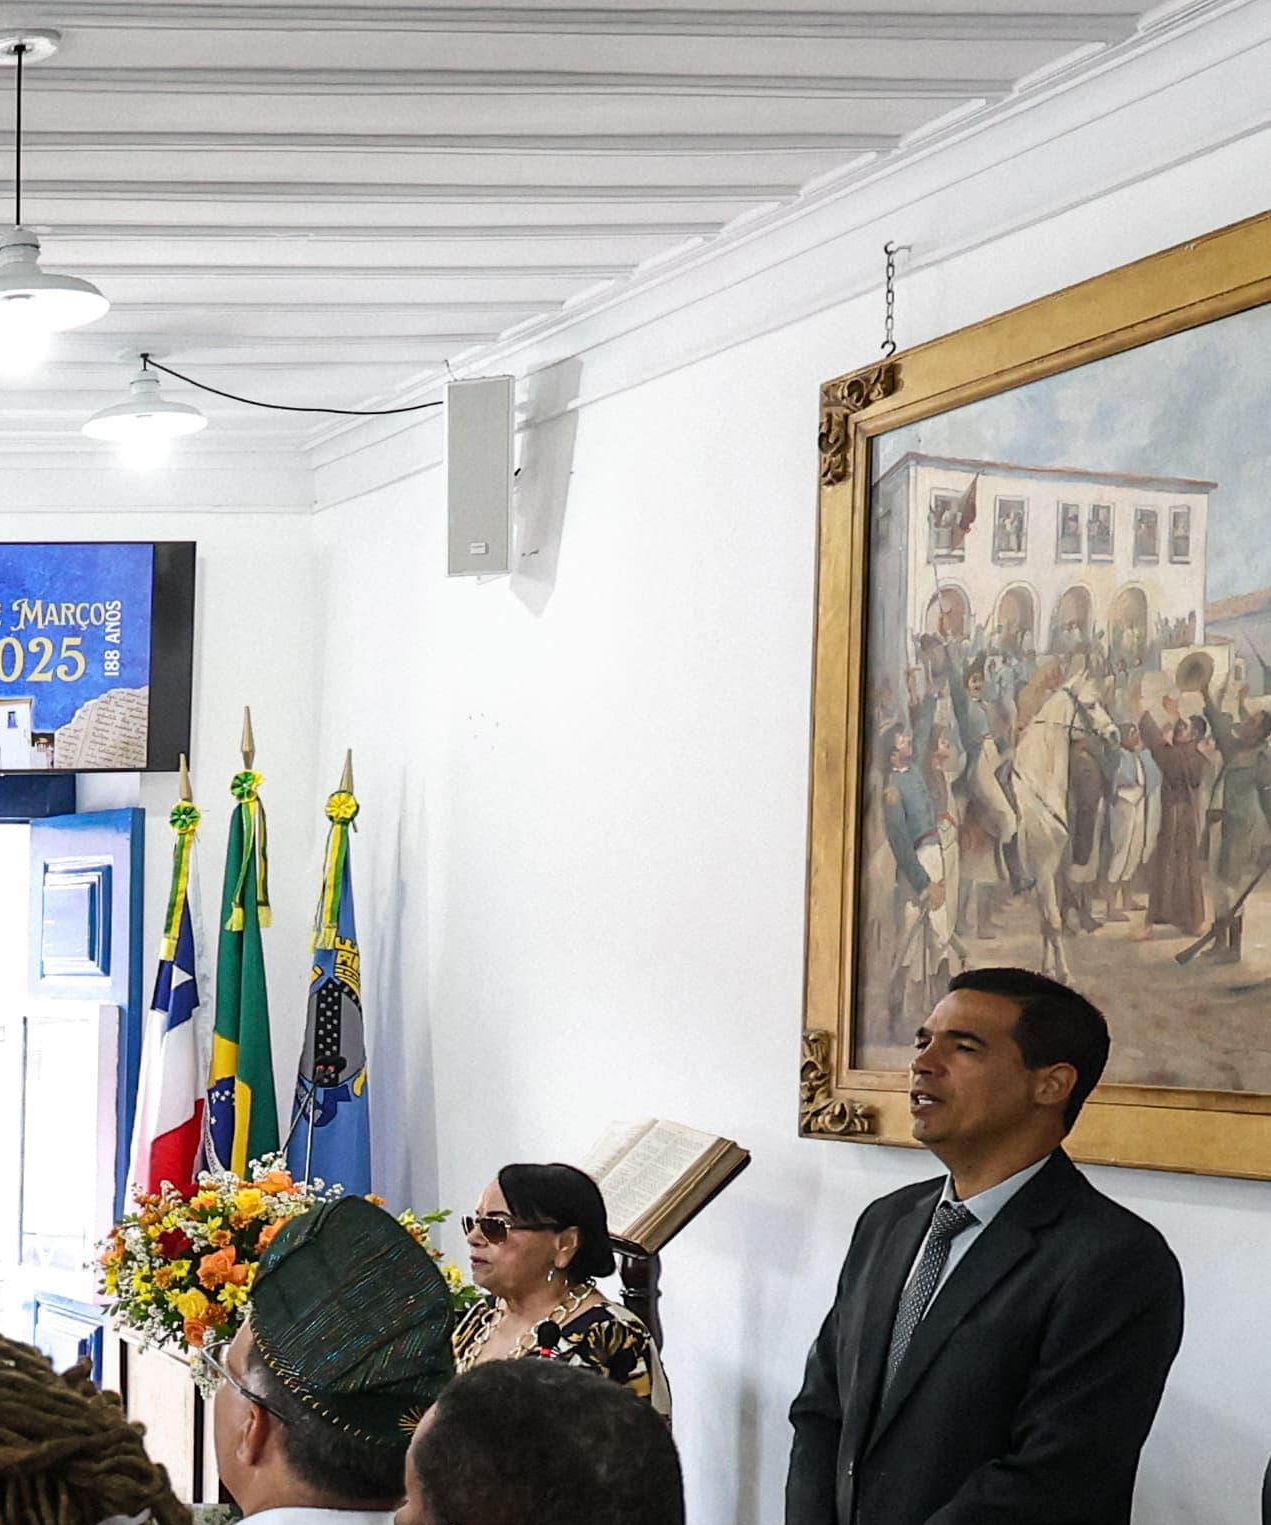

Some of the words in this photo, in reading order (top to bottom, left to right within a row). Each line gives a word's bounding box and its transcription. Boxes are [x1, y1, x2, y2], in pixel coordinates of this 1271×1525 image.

[10, 598, 106, 631] MARÇO
[105, 600, 122, 644] ANOS
[104, 649, 120, 677] 188
